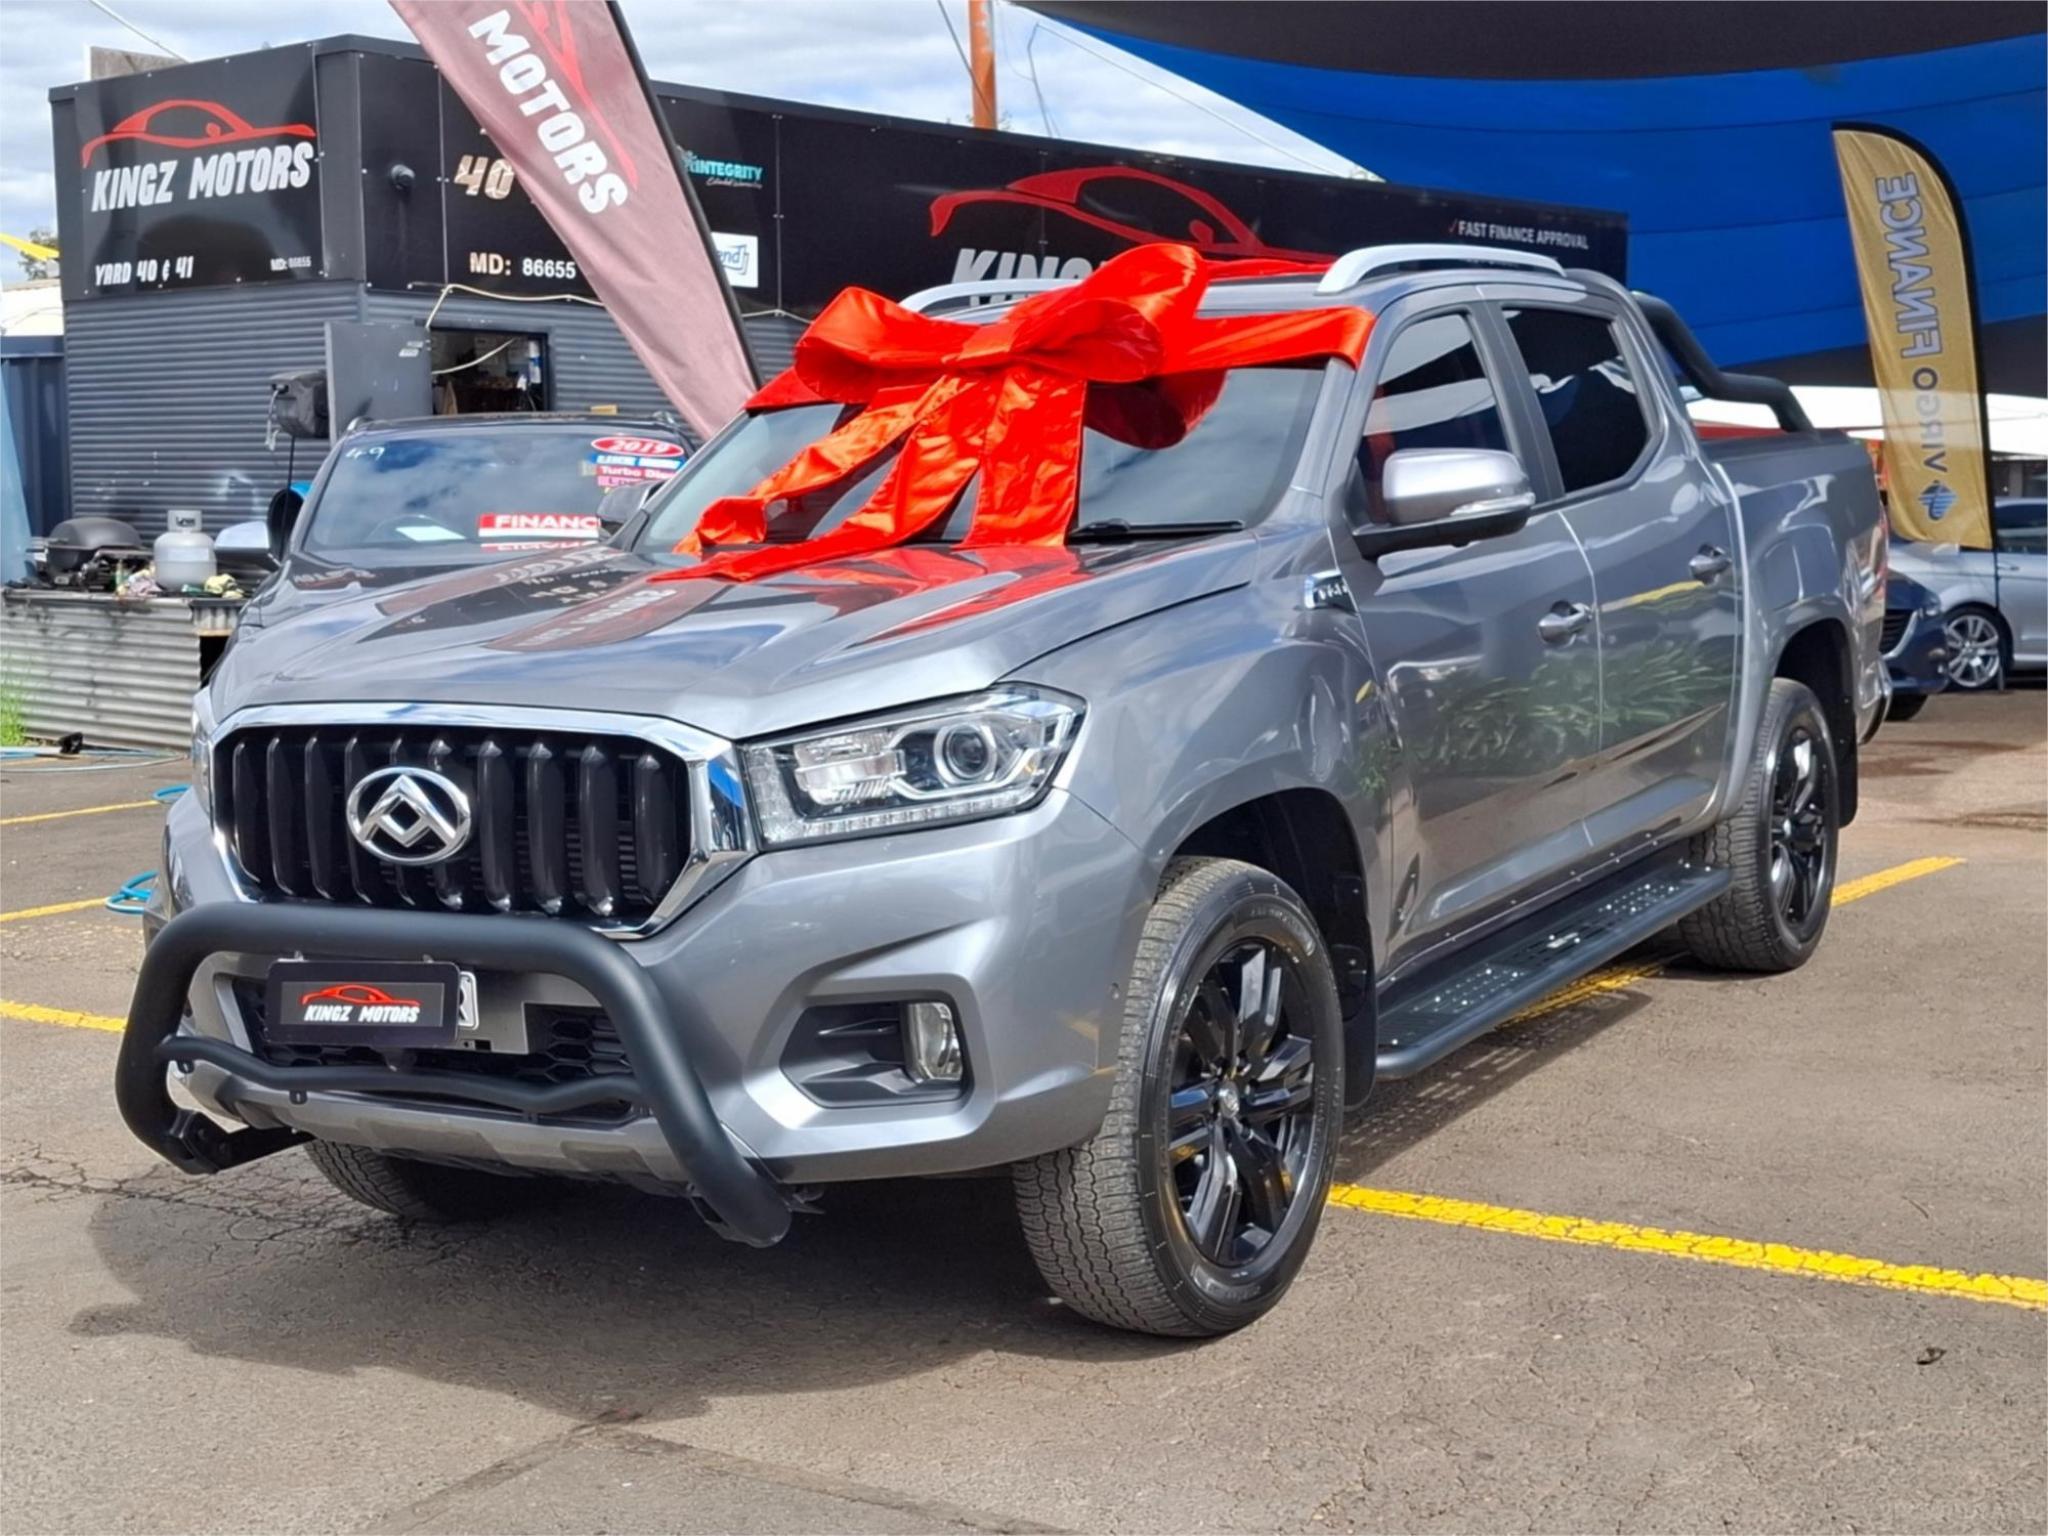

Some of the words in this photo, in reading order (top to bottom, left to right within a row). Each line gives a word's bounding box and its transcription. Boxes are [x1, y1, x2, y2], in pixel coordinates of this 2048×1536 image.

[467, 9, 628, 214] MOTORS
[91, 160, 178, 212] KINGZ
[188, 141, 314, 200] MOTORS
[453, 155, 515, 200] 40
[698, 159, 763, 181] INTEGRITY
[1458, 220, 1487, 237] FAST
[1489, 224, 1535, 243] FINANCE
[1536, 230, 1590, 250] APPROVAL
[95, 262, 132, 286] YARD
[136, 259, 158, 282] 40
[175, 256, 194, 278] 41
[469, 252, 512, 276] MD:
[522, 257, 576, 279] 86655
[601, 465, 643, 477] Turbo
[496, 514, 599, 529] FINANC
[304, 1005, 353, 1022] KINGZ
[358, 1005, 420, 1023] MOTORS
